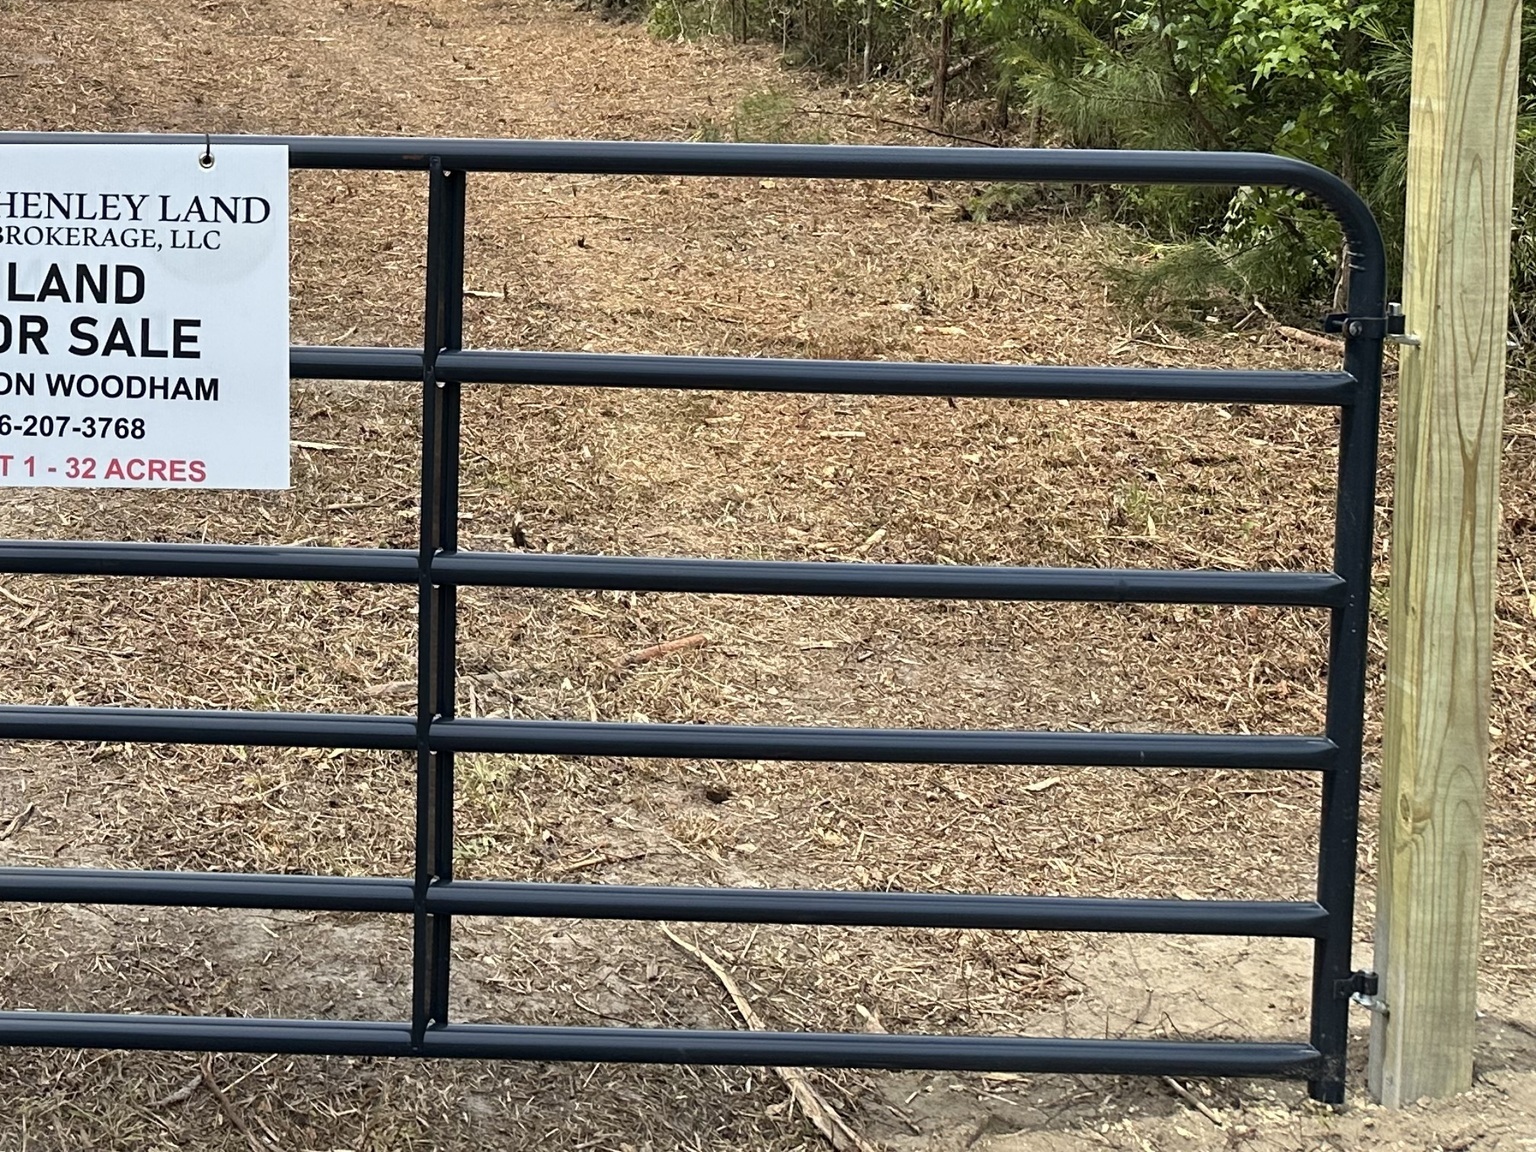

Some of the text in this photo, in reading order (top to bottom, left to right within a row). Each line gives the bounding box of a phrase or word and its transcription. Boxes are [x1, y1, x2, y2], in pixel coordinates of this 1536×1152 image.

[158, 194, 271, 224] LAND
[170, 229, 222, 250] LLC
[7, 262, 146, 305] LAND
[68, 316, 202, 359] SALE
[46, 373, 219, 401] WOODHAM
[23, 455, 36, 478] 1
[65, 456, 97, 480] 32
[104, 458, 207, 483] ACRES
